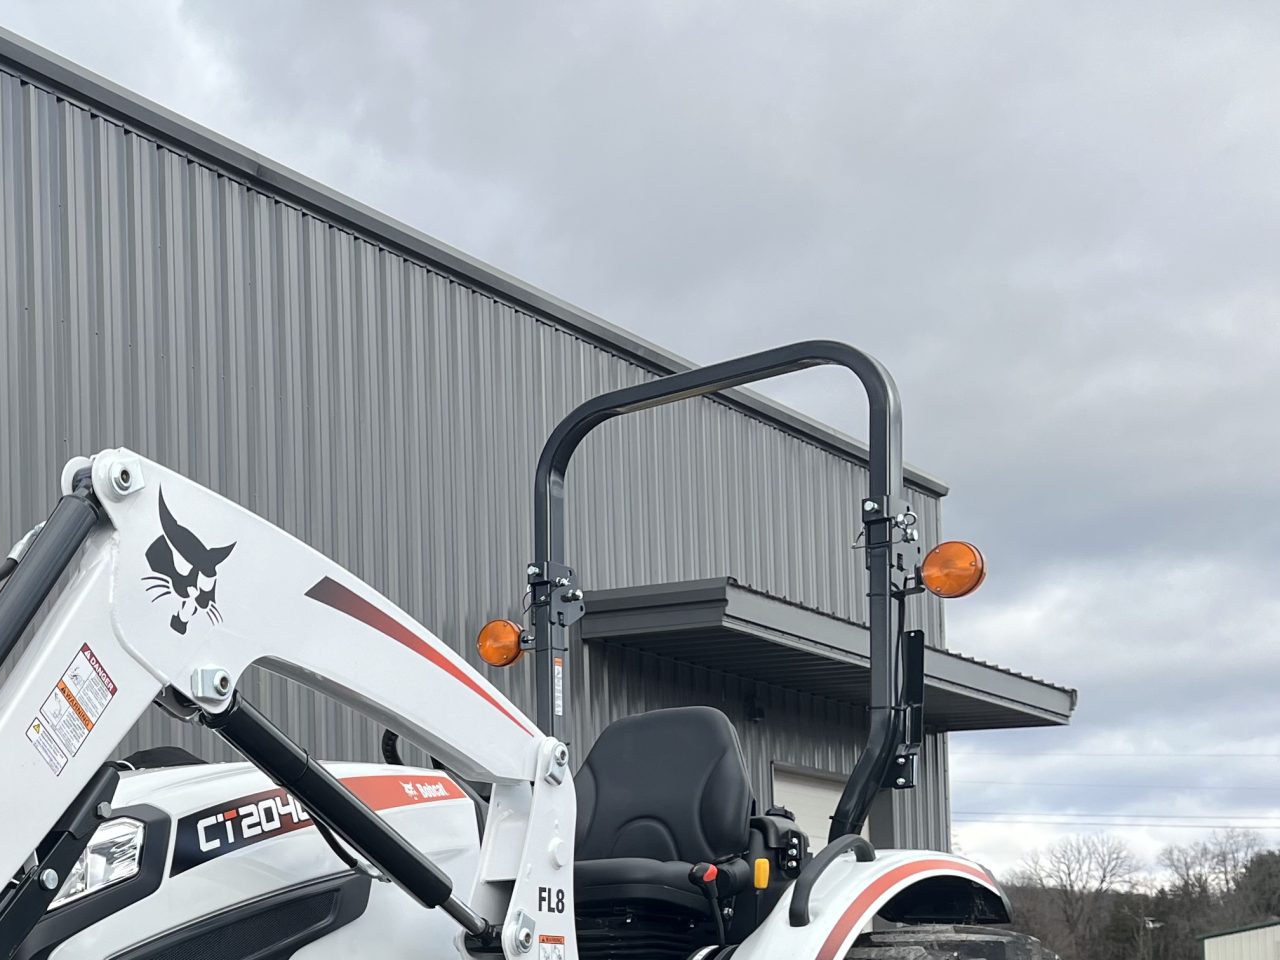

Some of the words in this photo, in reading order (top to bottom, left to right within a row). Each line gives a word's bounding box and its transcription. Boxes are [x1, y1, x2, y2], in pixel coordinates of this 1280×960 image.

[90, 656, 114, 692] DANGER
[66, 691, 90, 727] WARNING
[538, 886, 565, 914] FL8
